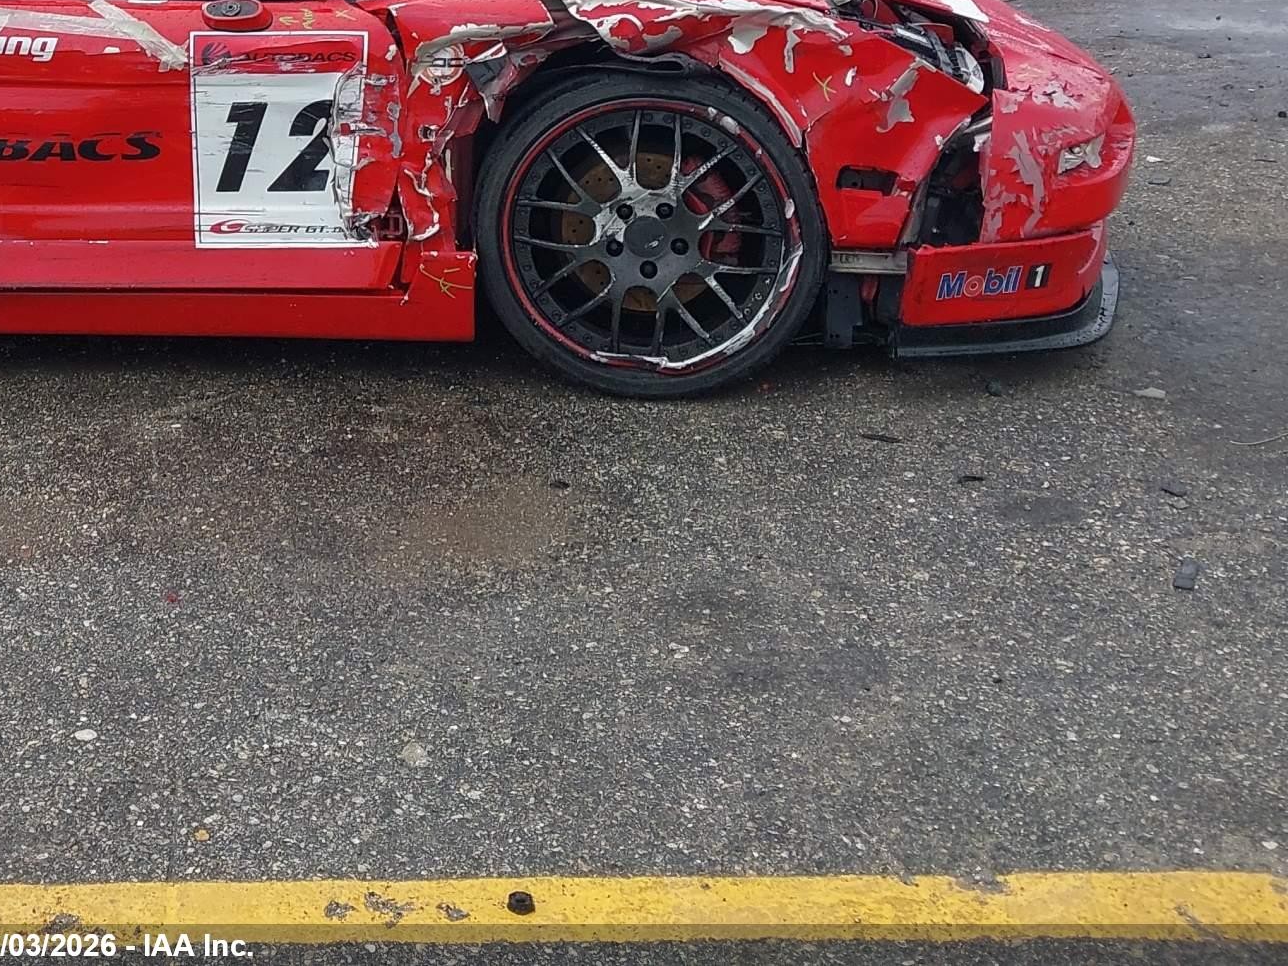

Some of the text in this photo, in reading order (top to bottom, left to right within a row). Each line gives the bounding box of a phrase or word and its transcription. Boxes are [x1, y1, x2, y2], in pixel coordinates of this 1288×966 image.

[216, 99, 334, 192] 12
[935, 265, 1046, 301] Mobil 1
